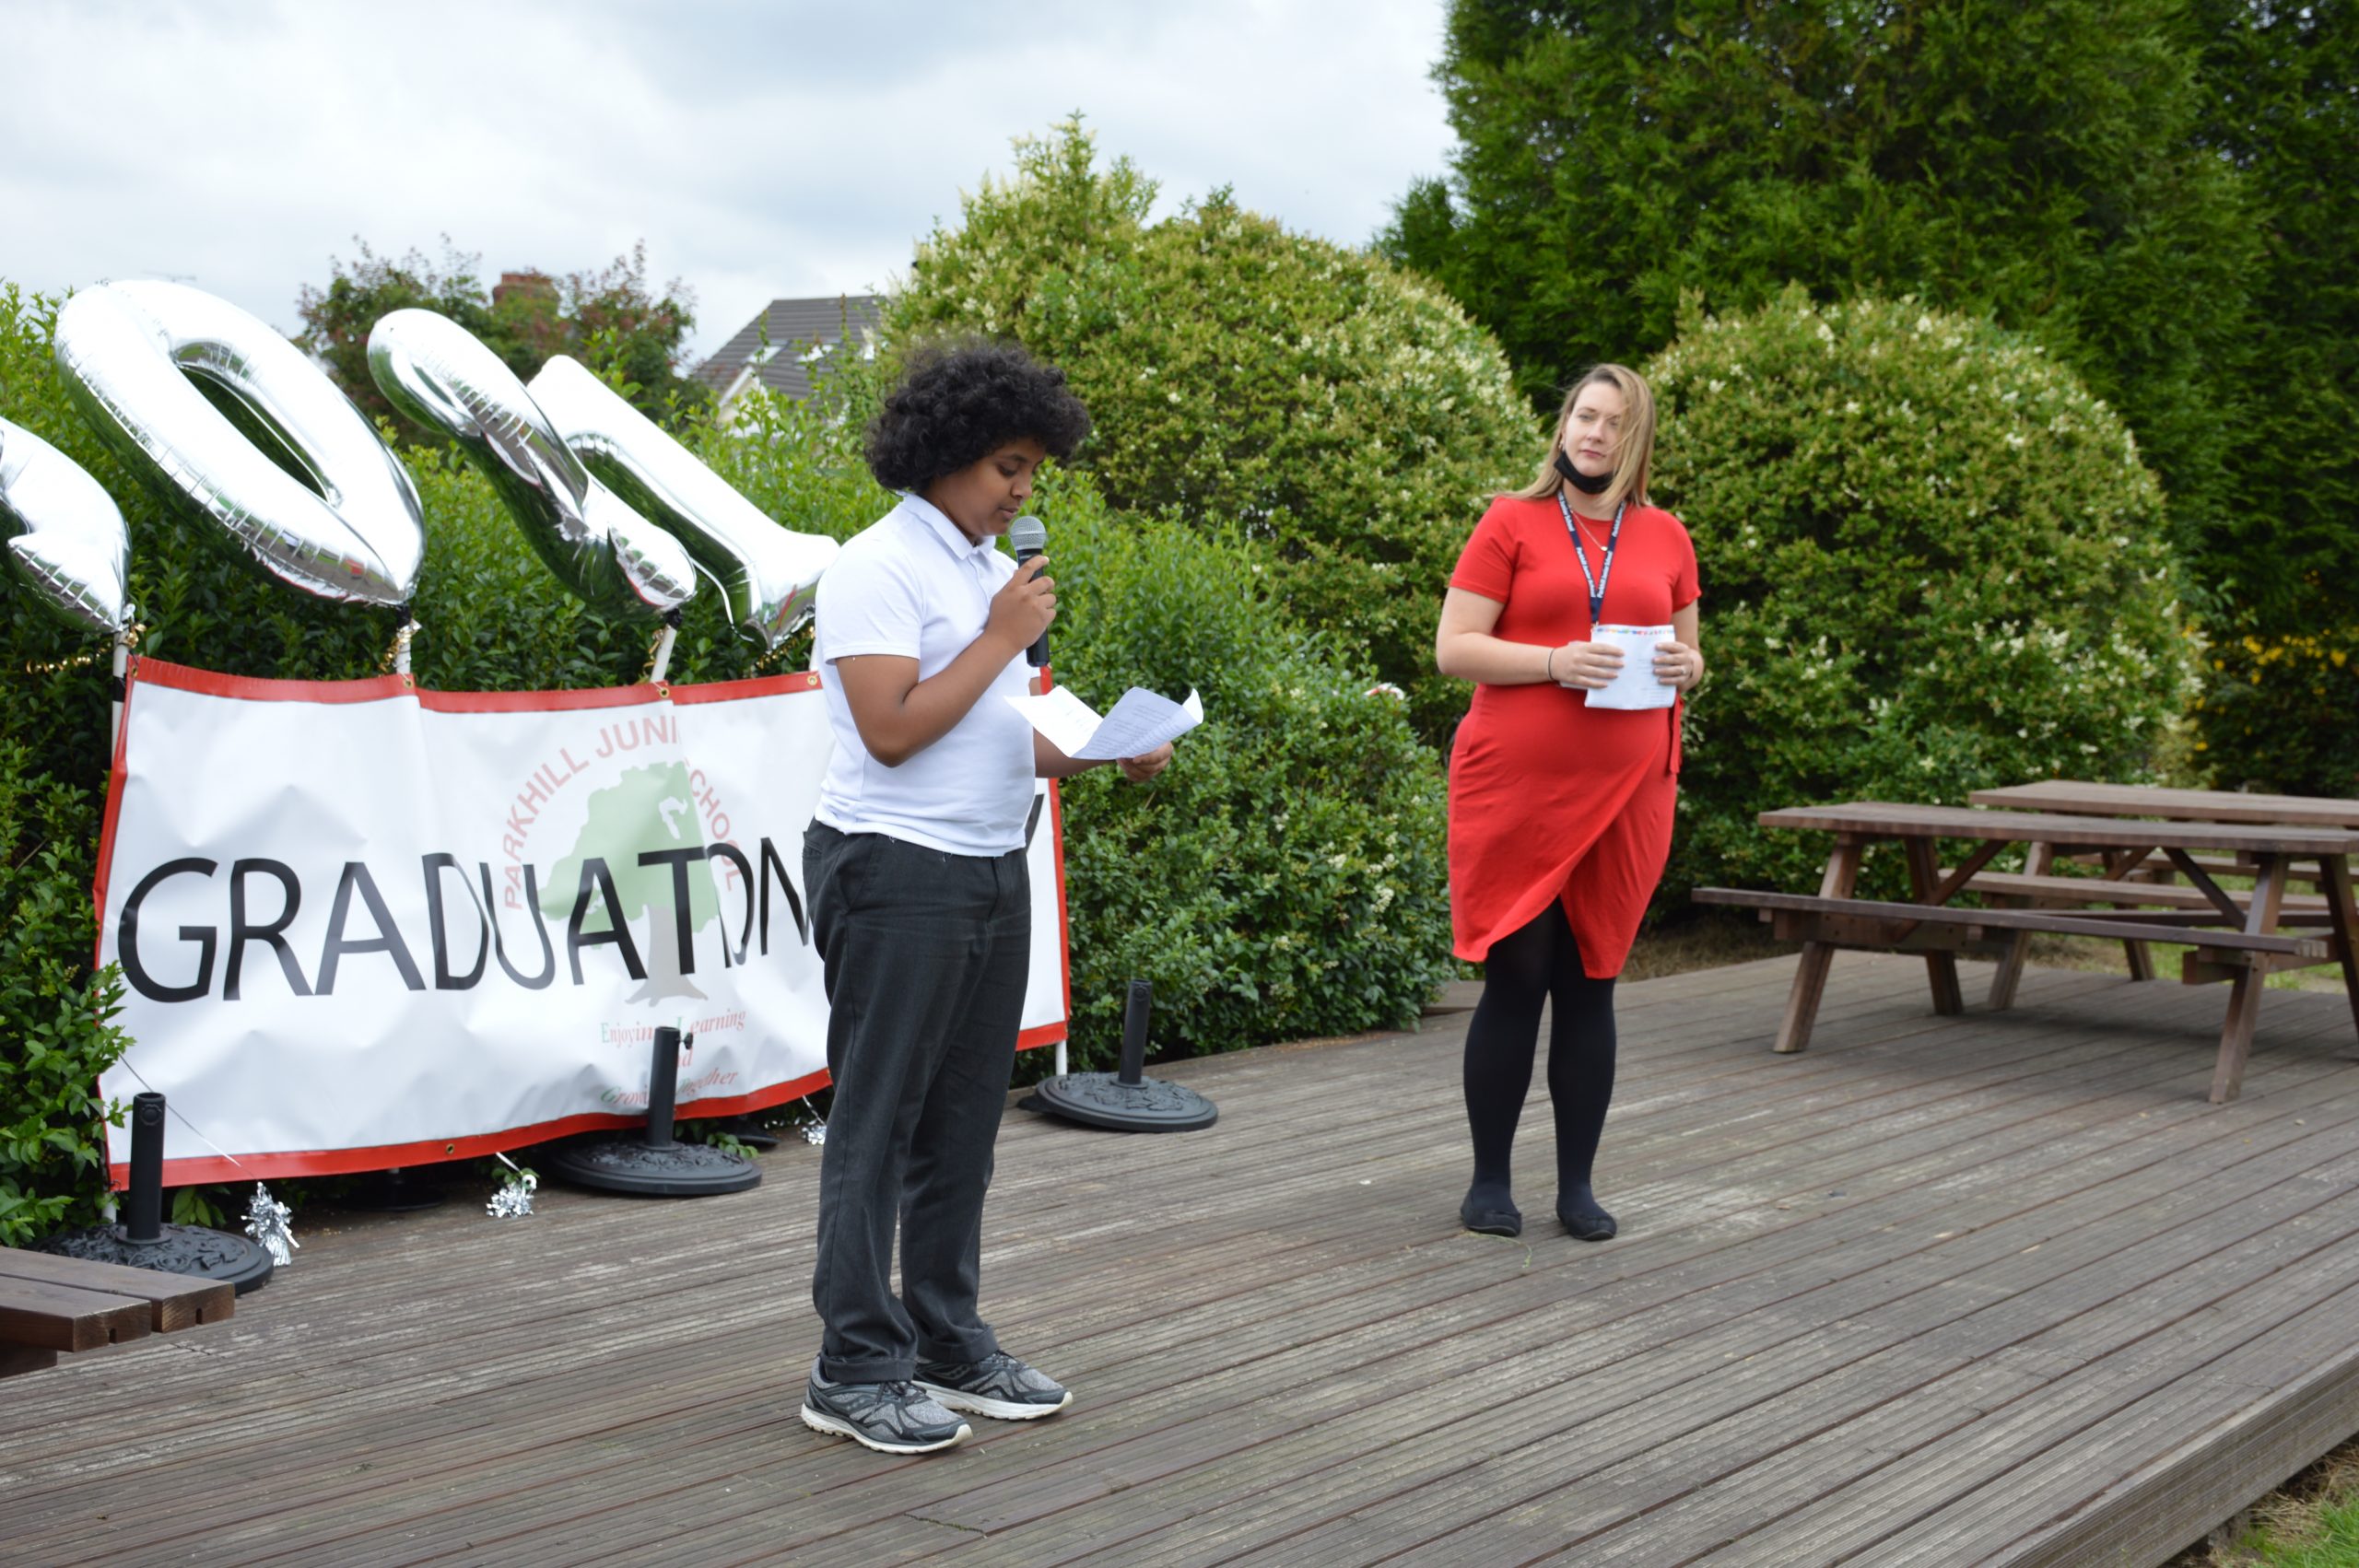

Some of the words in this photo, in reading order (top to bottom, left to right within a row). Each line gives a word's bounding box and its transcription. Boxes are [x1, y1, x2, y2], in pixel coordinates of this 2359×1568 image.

[504, 747, 591, 910] PARKHILL
[595, 715, 679, 758] JUNI
[685, 756, 741, 892] CHOOL
[601, 1021, 654, 1047] Enjoyin
[601, 1086, 649, 1106] Growi
